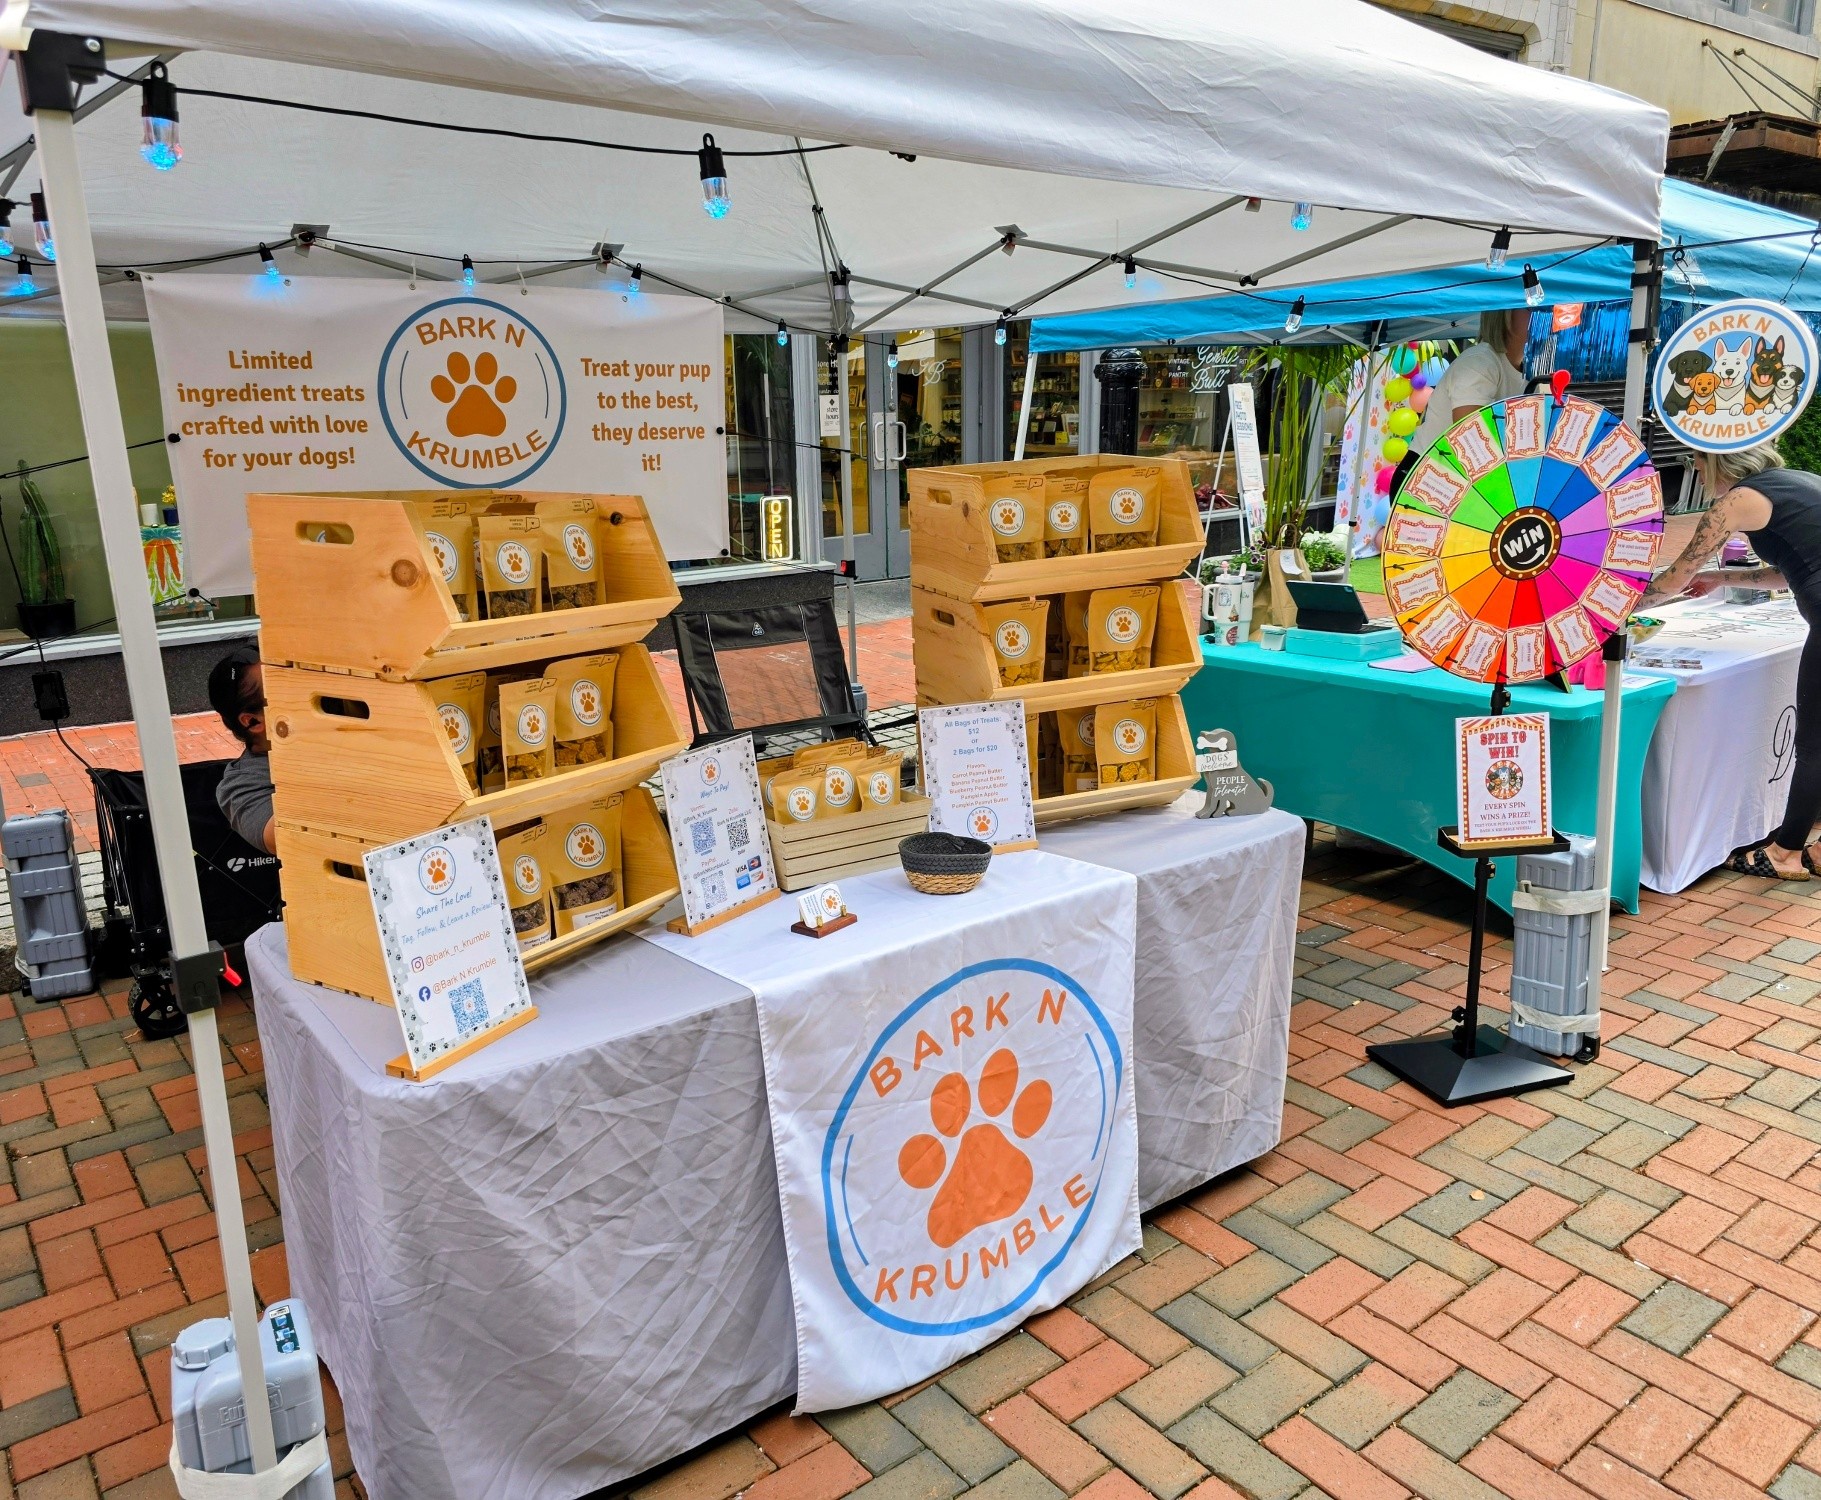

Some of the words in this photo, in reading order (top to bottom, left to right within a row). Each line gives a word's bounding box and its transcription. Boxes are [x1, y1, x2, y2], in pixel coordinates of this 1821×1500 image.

[416, 316, 496, 345] BARK
[504, 323, 525, 348] N
[1693, 313, 1752, 342] BARK
[1755, 316, 1772, 335] N
[228, 350, 313, 370] Limited
[580, 358, 630, 377] Treat
[634, 362, 675, 382] your
[680, 363, 711, 382] pup
[1189, 367, 1230, 392] Bull
[177, 383, 296, 408] ingredient
[300, 384, 366, 402] treats
[597, 391, 617, 409] to
[621, 390, 651, 409] the
[656, 390, 699, 412] best,
[181, 415, 264, 436] crafted
[269, 414, 320, 434] with
[325, 414, 368, 434] love
[591, 422, 633, 445] they
[638, 421, 705, 440] deserve
[1677, 414, 1770, 438] KRUMBLE
[202, 448, 237, 468] for
[242, 452, 293, 472] your
[298, 446, 355, 470] dogs!
[406, 429, 548, 470] KRUMBLE
[641, 453, 662, 471] it!
[1114, 511, 1140, 520] KRUMBLE
[769, 499, 783, 558] OPEN
[576, 685, 589, 693] BARK
[954, 719, 970, 728] Bags
[981, 716, 1002, 724] Treats:
[1480, 732, 1508, 746] SPIN
[1512, 731, 1527, 743] TO
[958, 748, 975, 756] Bags
[1206, 753, 1229, 763] DOGS
[1488, 745, 1519, 759] WIN!
[1214, 783, 1249, 797] tolerated
[1216, 776, 1246, 785] PEOPLE
[1480, 813, 1500, 821] WINS
[1508, 811, 1531, 819] PRIZE!
[1484, 802, 1507, 810] EVERY
[573, 827, 588, 837] BARK
[423, 850, 440, 863] BARK
[573, 850, 602, 863] KRUMBLE
[735, 864, 747, 873] VISA
[426, 876, 455, 891] KRUMBLE
[415, 902, 438, 919] Share
[440, 898, 453, 909] The
[455, 886, 473, 903] Love!
[440, 920, 446, 929] &
[446, 914, 464, 927] Leave
[471, 898, 493, 917] Review!
[425, 930, 491, 967] @bark_n_krumble
[432, 975, 458, 994] @Bark
[459, 970, 466, 980] N
[466, 957, 497, 977] Krumble
[869, 992, 1010, 1098] BARK
[1036, 988, 1067, 1025] N
[873, 1173, 1093, 1303] KRUMBLE
